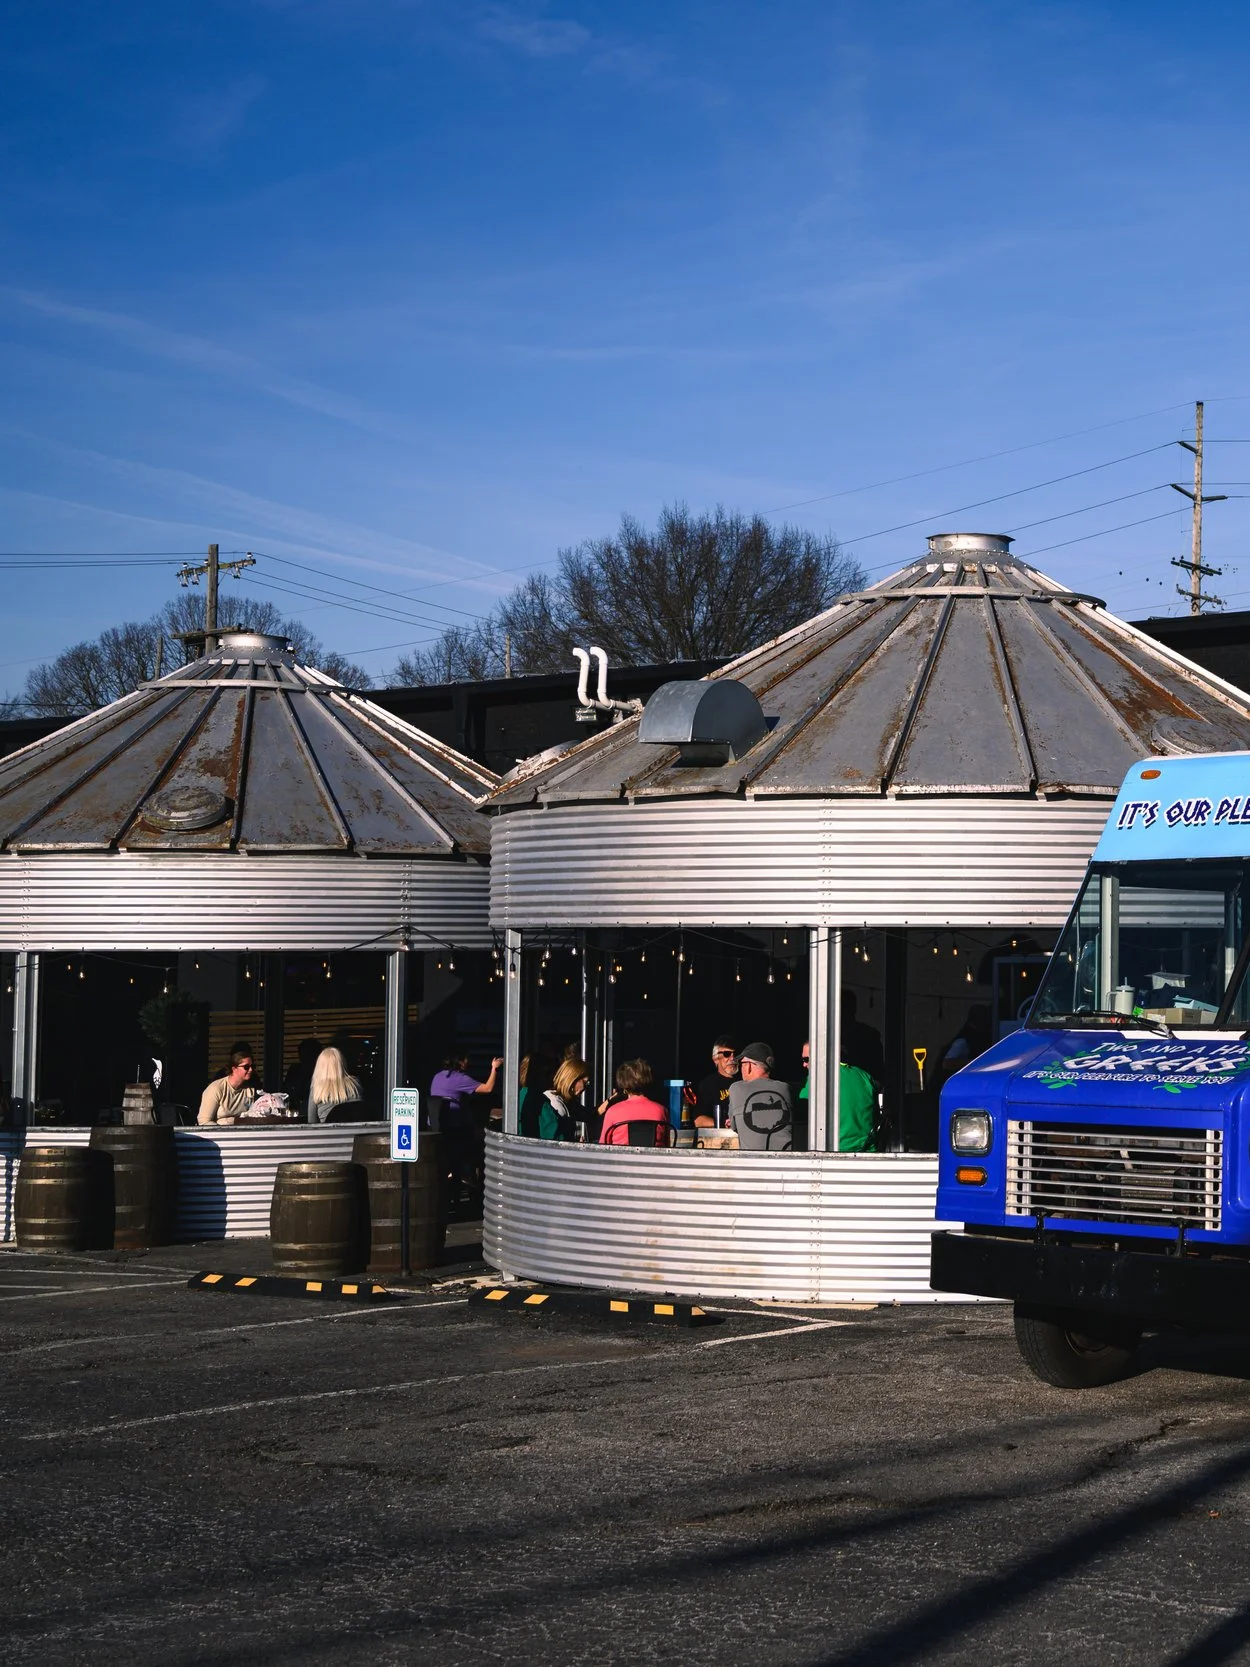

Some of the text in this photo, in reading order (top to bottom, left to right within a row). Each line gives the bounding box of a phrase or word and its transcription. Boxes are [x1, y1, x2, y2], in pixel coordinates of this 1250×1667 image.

[1117, 802, 1159, 828] IT'S
[1164, 798, 1210, 826] OUR
[1140, 1045, 1187, 1054] AND
[1062, 1054, 1248, 1072] GREEKS
[393, 1096, 416, 1105] RESERVED
[394, 1108, 415, 1117] PARKING
